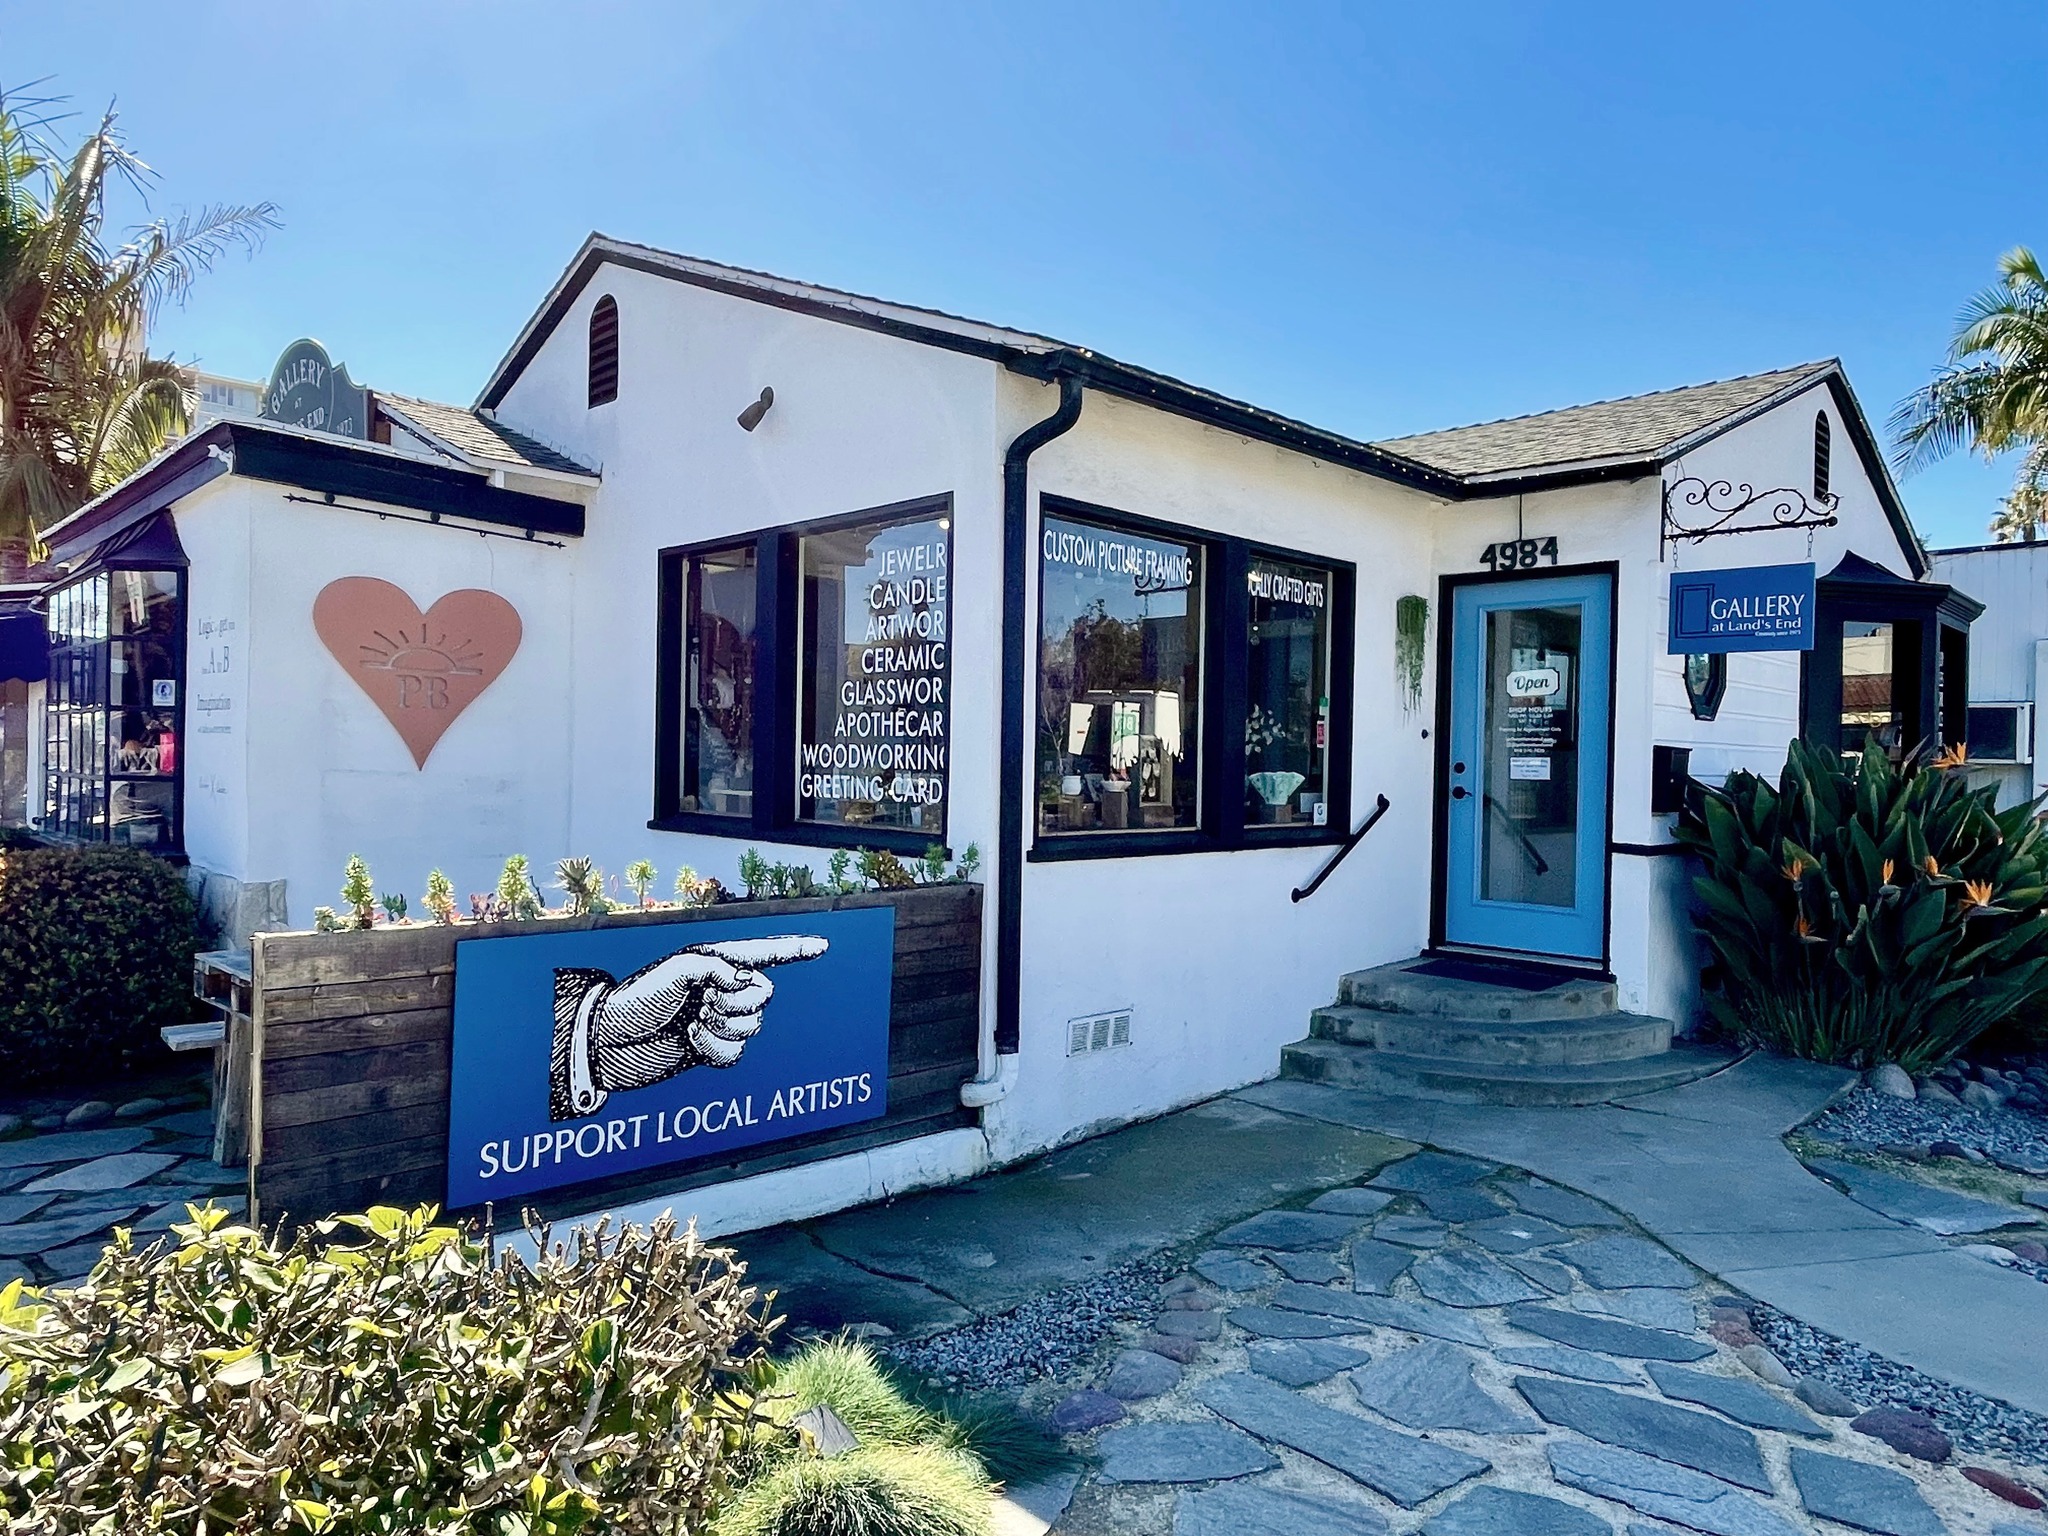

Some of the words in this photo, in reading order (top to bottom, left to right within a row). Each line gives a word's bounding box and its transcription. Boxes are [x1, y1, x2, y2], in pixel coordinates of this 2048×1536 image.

[271, 358, 326, 415] GALLERY
[878, 542, 947, 577] JEWELR
[1043, 530, 1096, 568] CUSTOM
[1098, 540, 1143, 576] PICTURE
[1144, 550, 1193, 585] FRAMING
[1480, 536, 1558, 572] 4984
[870, 576, 946, 609] CANDLE
[1272, 575, 1304, 604] CRAFTED
[1304, 581, 1324, 608] GIFTS
[1710, 594, 1805, 620] GALLERY
[864, 609, 945, 643] ARTWOR
[1711, 621, 1724, 632] at
[1727, 619, 1771, 631] Land's
[1775, 617, 1801, 629] End
[861, 642, 945, 674] CERAMIC
[395, 674, 449, 710] PB
[841, 676, 944, 707] GLASSWOR
[1514, 675, 1550, 693] Open
[834, 710, 944, 738] APOTHECAR
[800, 773, 885, 802] GREETING
[890, 777, 943, 804] CARD
[479, 1114, 649, 1179] SUPPORT
[656, 1095, 759, 1143] LOCAL
[766, 1072, 872, 1122] ARTISTS
